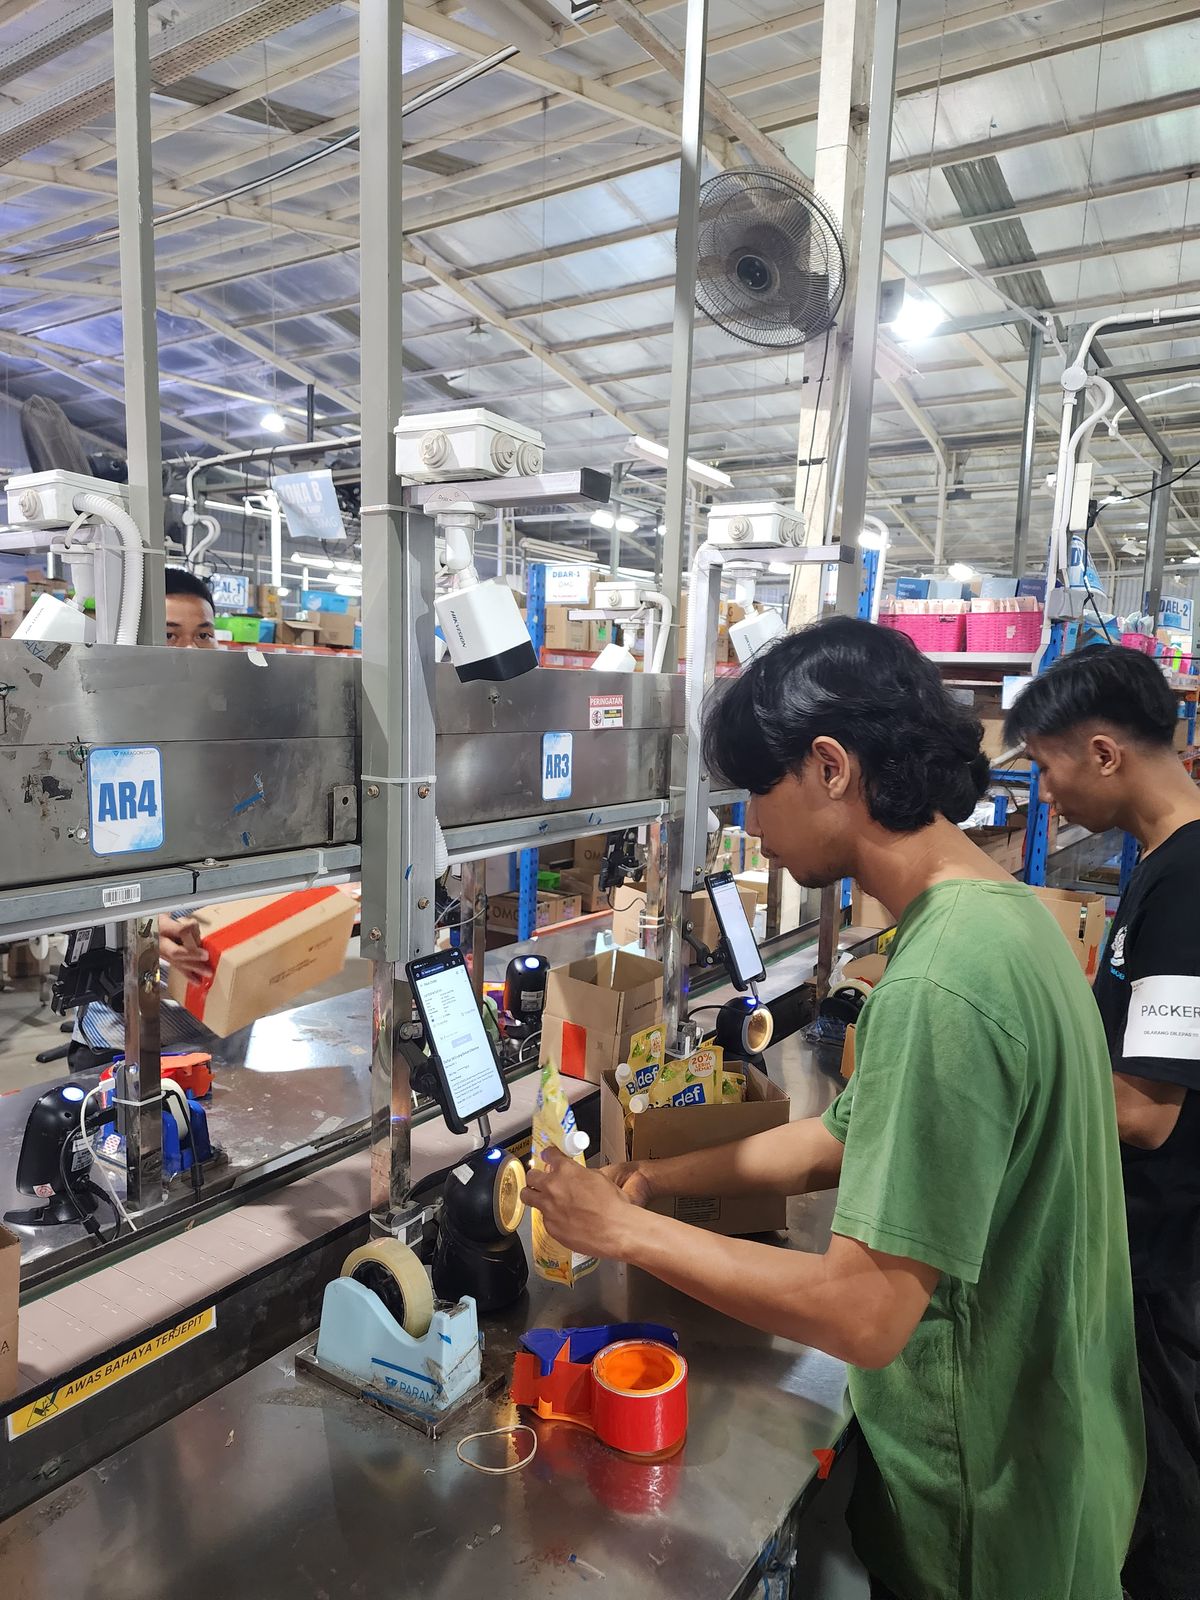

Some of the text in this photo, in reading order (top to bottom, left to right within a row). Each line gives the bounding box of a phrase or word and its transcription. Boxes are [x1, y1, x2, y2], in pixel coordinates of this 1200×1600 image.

[1159, 599, 1189, 617] DAEL-2
[450, 610, 467, 648] HIKVISION
[591, 697, 623, 705] PERINGATAN
[546, 754, 569, 779] AR3
[98, 780, 157, 822] AR4
[1141, 1004, 1200, 1018] PACKER
[691, 1052, 713, 1064] 20%
[65, 1314, 204, 1398] AWAS BAHAYA TERJEPIT
